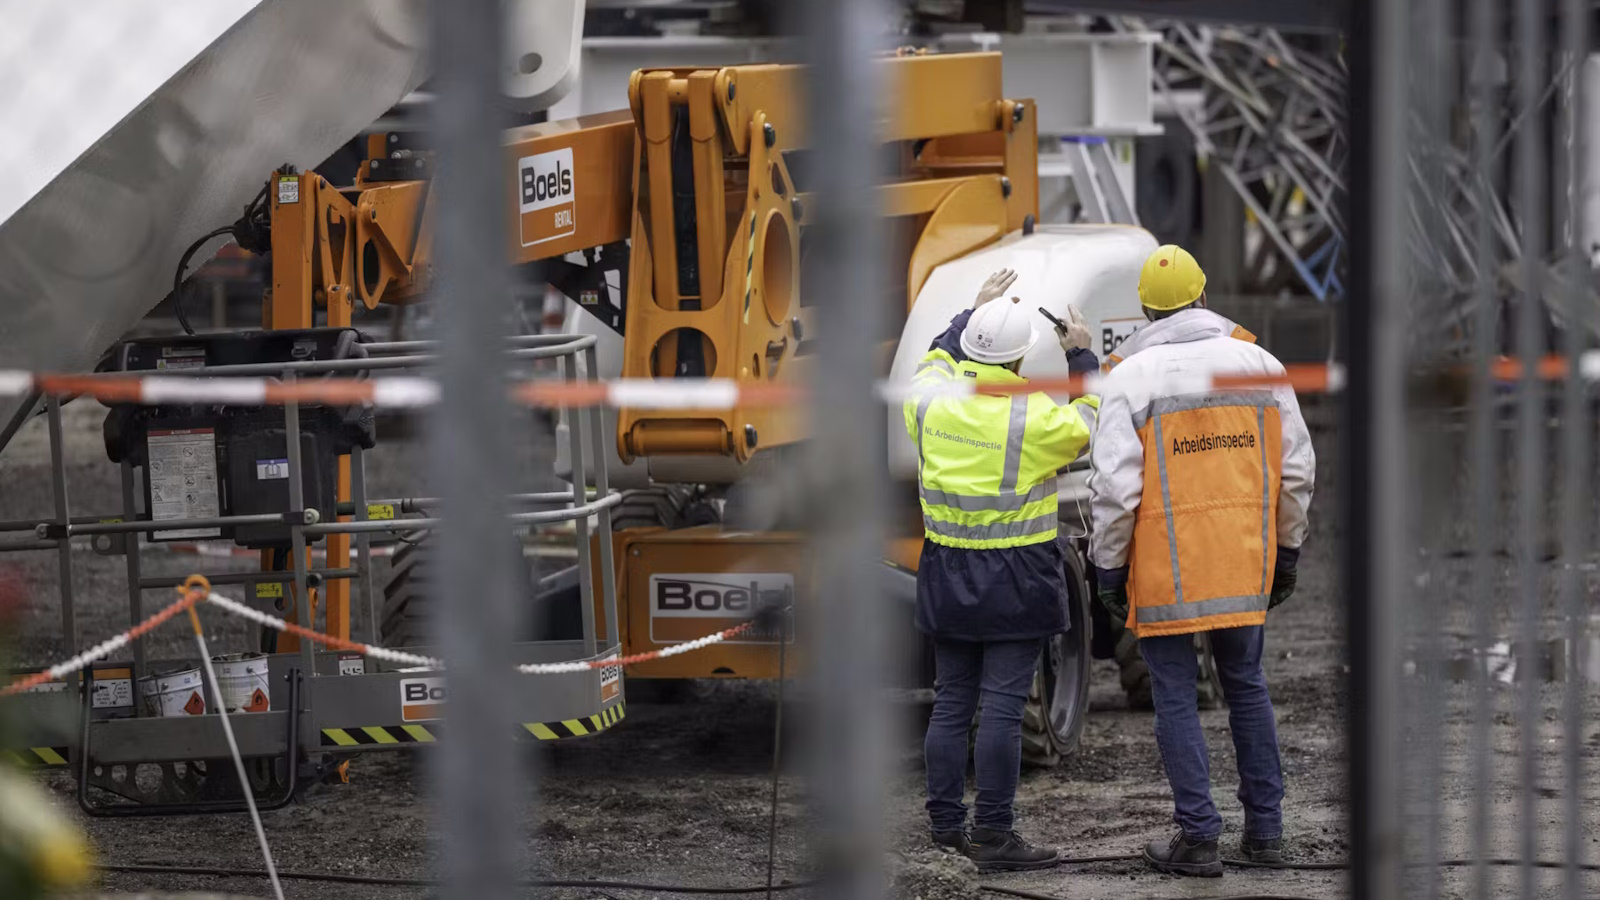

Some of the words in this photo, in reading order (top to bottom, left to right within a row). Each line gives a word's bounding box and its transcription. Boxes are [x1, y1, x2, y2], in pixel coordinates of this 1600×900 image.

[521, 160, 571, 205] Boels
[554, 210, 572, 228] RENTAL
[924, 426, 934, 436] NL
[934, 429, 1002, 450] Arbeidsinspectie
[1173, 430, 1255, 456] Arbeidsinspectie
